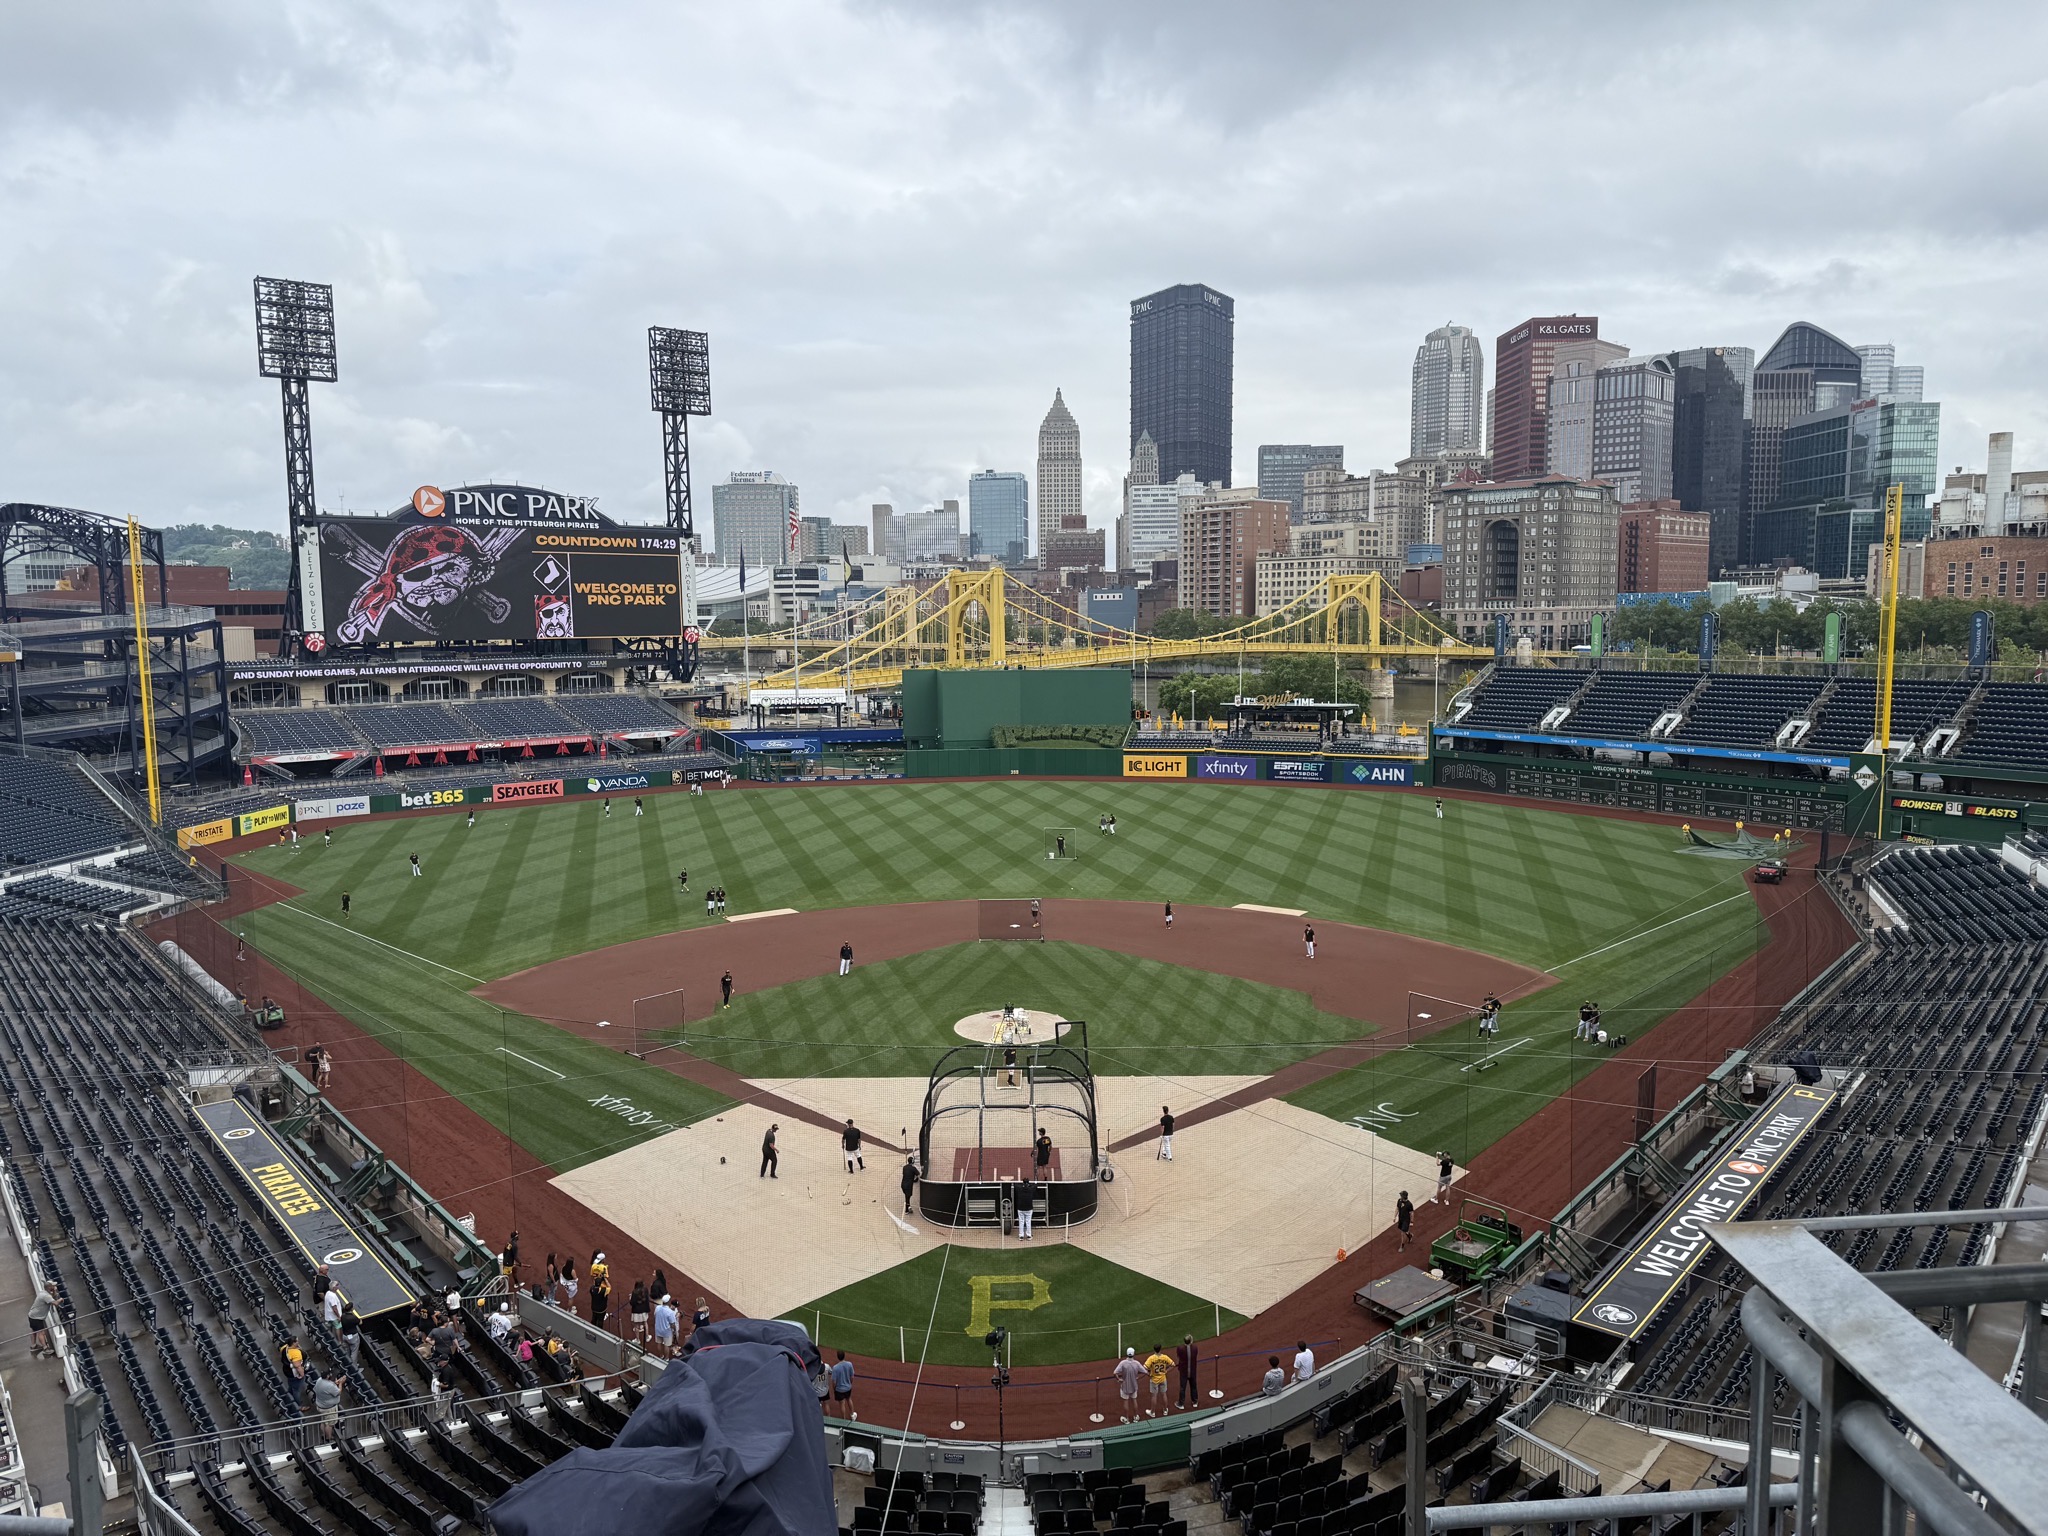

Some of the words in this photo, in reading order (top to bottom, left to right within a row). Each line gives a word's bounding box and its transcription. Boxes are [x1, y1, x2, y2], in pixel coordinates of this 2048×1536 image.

[1204, 291, 1221, 307] UPMC
[1131, 300, 1153, 315] UPMC
[1517, 328, 1529, 341] GATES
[1539, 325, 1558, 334] K&L
[1559, 325, 1591, 334] GATES
[451, 491, 518, 517] PNC
[524, 494, 600, 520] PARK
[455, 517, 481, 525] HOME
[515, 520, 565, 528] PITTSBURGH
[535, 535, 637, 548] COUNTDOWN
[640, 538, 677, 550] 174:29
[307, 549, 315, 578] LETZ
[308, 582, 315, 597] GO
[574, 583, 655, 594] WELCOME
[656, 583, 677, 594] TO
[587, 595, 622, 606] PNC
[624, 595, 667, 606] PARK
[233, 671, 255, 679] AND
[256, 670, 295, 679] SUNDAY
[297, 669, 323, 677] HOME
[324, 668, 358, 677] GAMES,
[359, 667, 374, 675] ALL
[374, 667, 397, 675] FANS
[398, 666, 407, 674] IN
[408, 664, 463, 673] ATTENDANCE
[463, 664, 481, 672] WILL
[481, 663, 504, 671] HAVE
[504, 662, 519, 670] THE
[519, 661, 571, 670] OPPORTUNITY
[1256, 692, 1300, 711] Miller
[1293, 698, 1315, 706] TIME
[1145, 761, 1182, 772] LIGHT
[1205, 760, 1248, 776] xfinity
[1273, 761, 1302, 771] ESPN
[1302, 762, 1325, 772] BET
[601, 776, 648, 788] VANDA
[1371, 768, 1405, 782] AHN
[1442, 764, 1497, 788] PIRATES
[401, 789, 464, 807] bet365
[497, 782, 559, 800] SEATGEEK
[303, 805, 324, 814] PNC
[336, 801, 365, 813] paze
[1900, 799, 1943, 812] BOWSER
[1974, 807, 2018, 819] BLASTS
[253, 816, 268, 827] PLAY
[273, 811, 288, 822] WIN!
[194, 825, 224, 840] TRISTATE
[1906, 835, 1935, 846] BOWSER
[587, 1094, 663, 1126] xfinity
[1739, 1138, 1783, 1167] PNC
[1761, 1113, 1804, 1142] PARK
[252, 1162, 322, 1217] PIRATES
[1633, 1194, 1735, 1277] WELCOME
[1713, 1173, 1751, 1194] TO
[964, 1272, 1053, 1338] P
[492, 1324, 499, 1332] 21
[1154, 1364, 1165, 1374] 22
